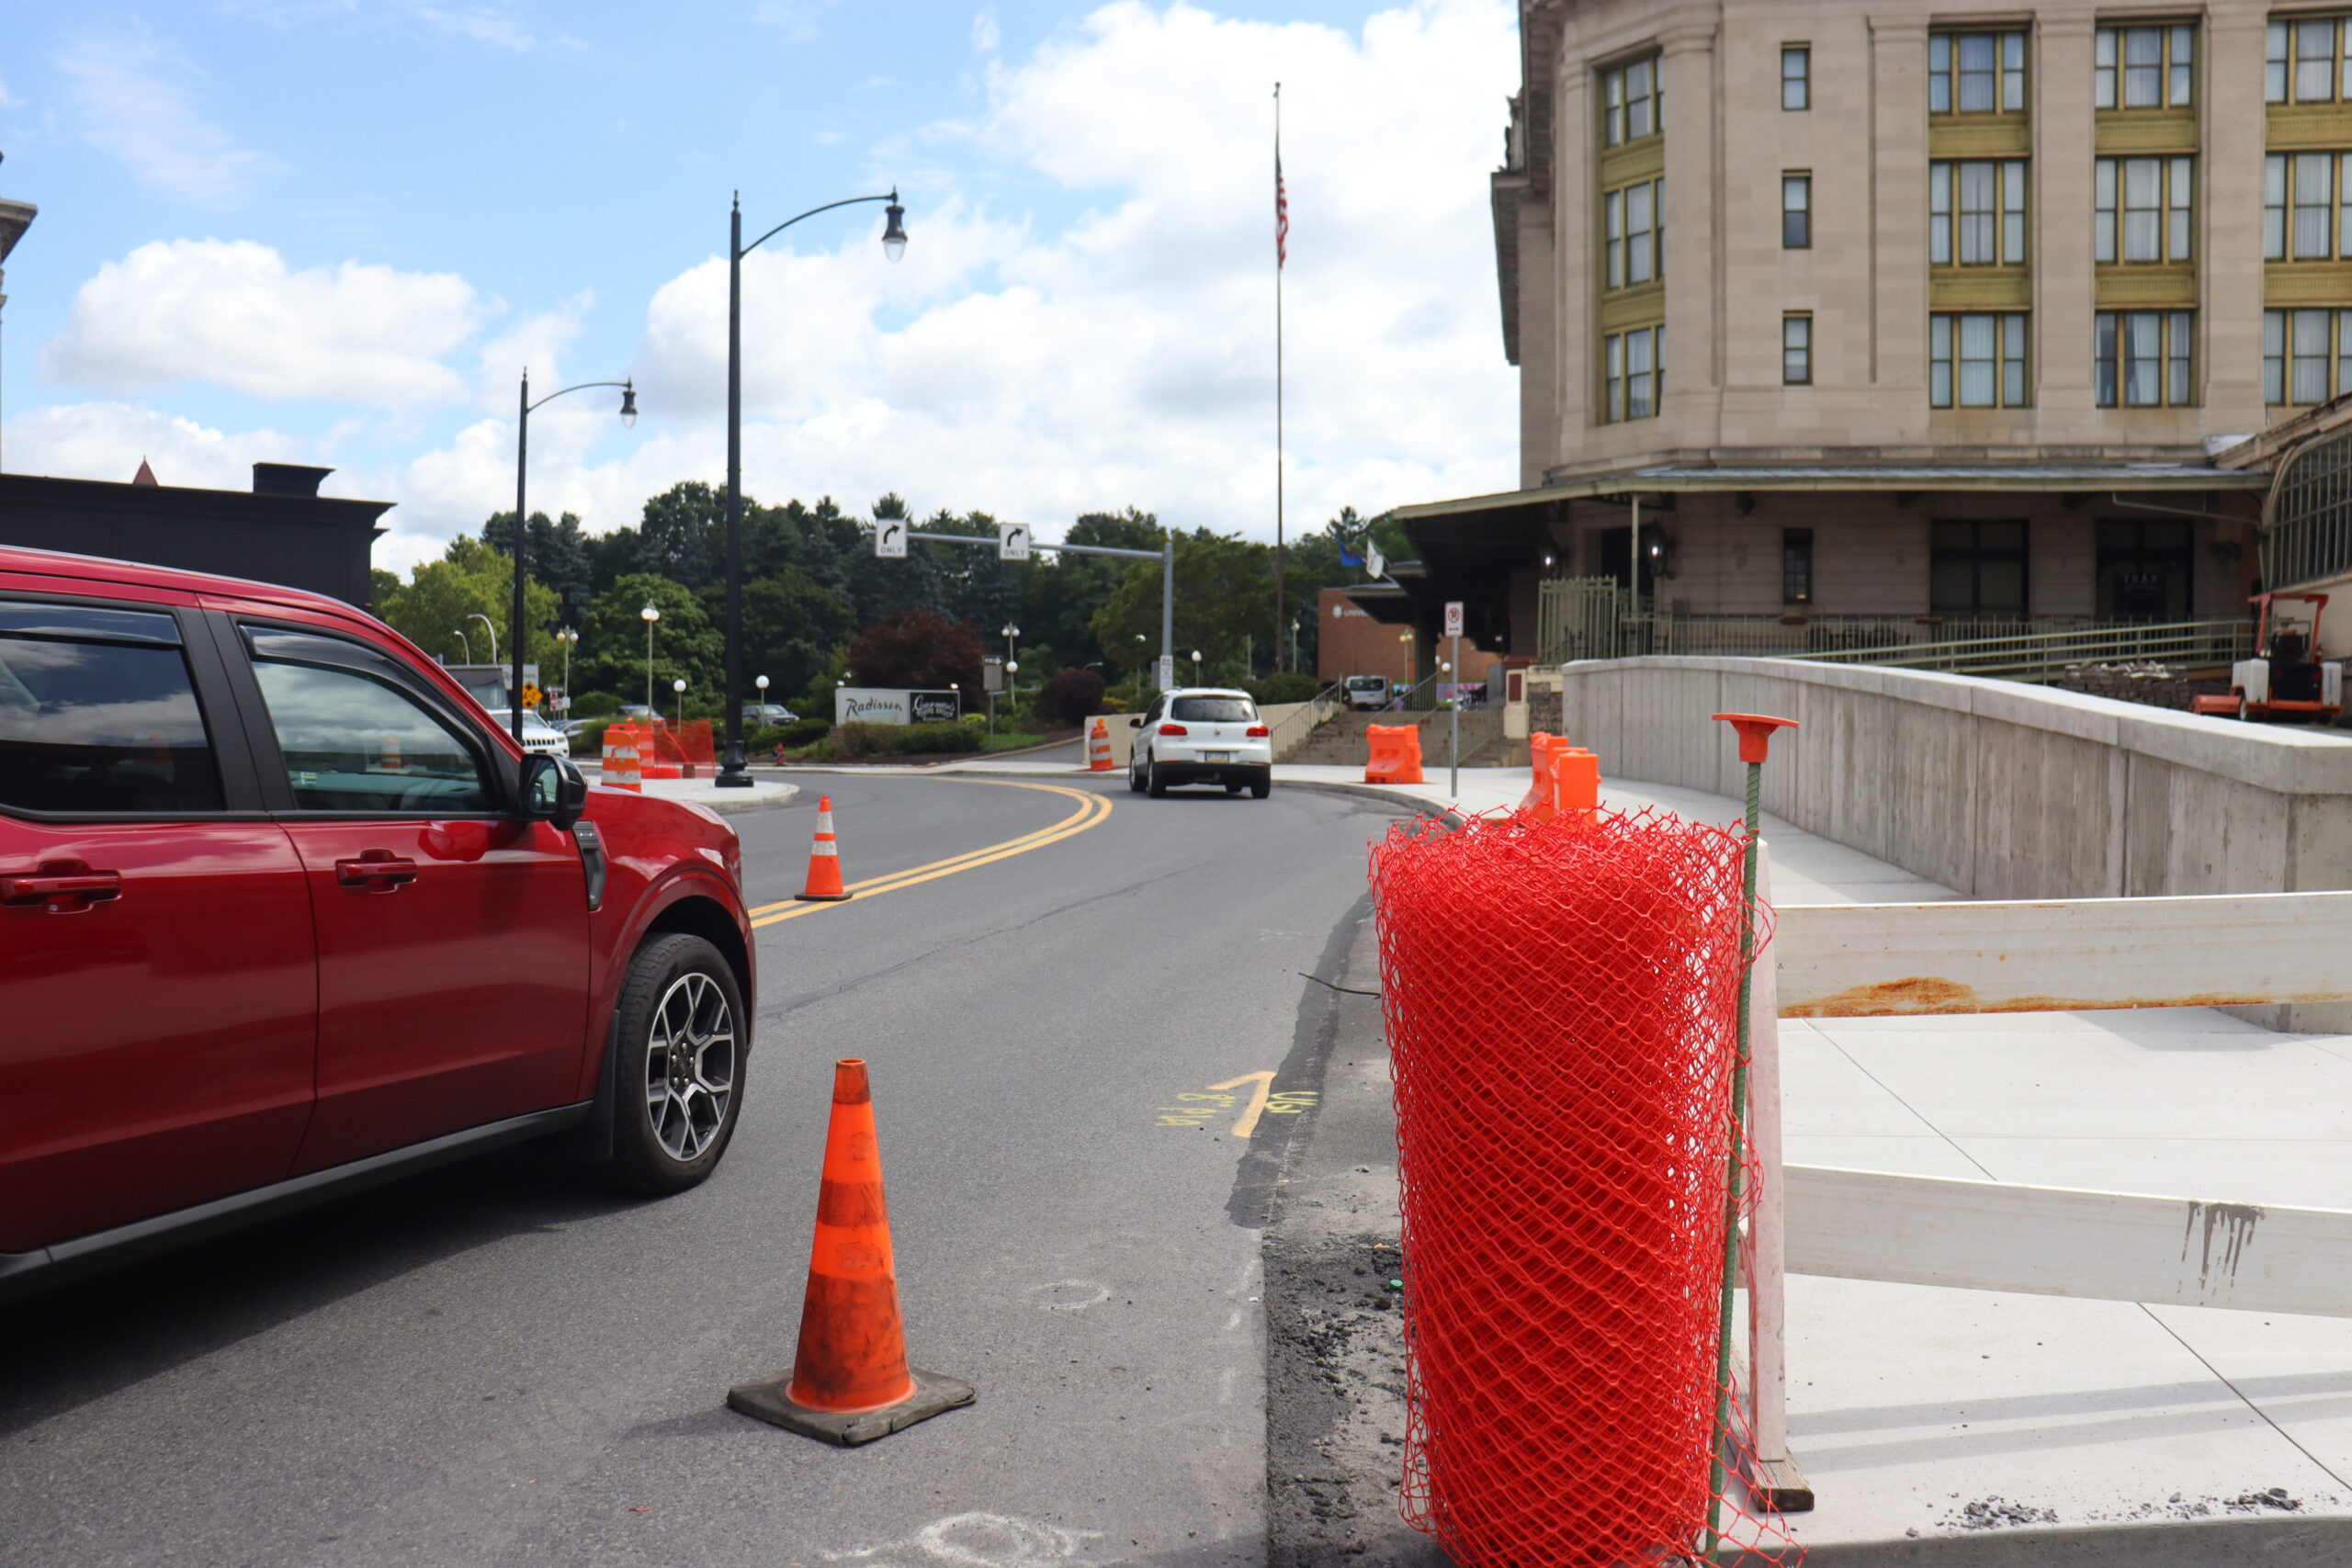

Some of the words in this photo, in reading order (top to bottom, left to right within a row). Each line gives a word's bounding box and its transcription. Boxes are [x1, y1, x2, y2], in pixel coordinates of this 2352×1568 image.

[880, 546, 903, 555] ONLY
[1003, 549, 1026, 558] ONLY
[2123, 572, 2158, 584] TRAX
[846, 696, 903, 716] Radisson
